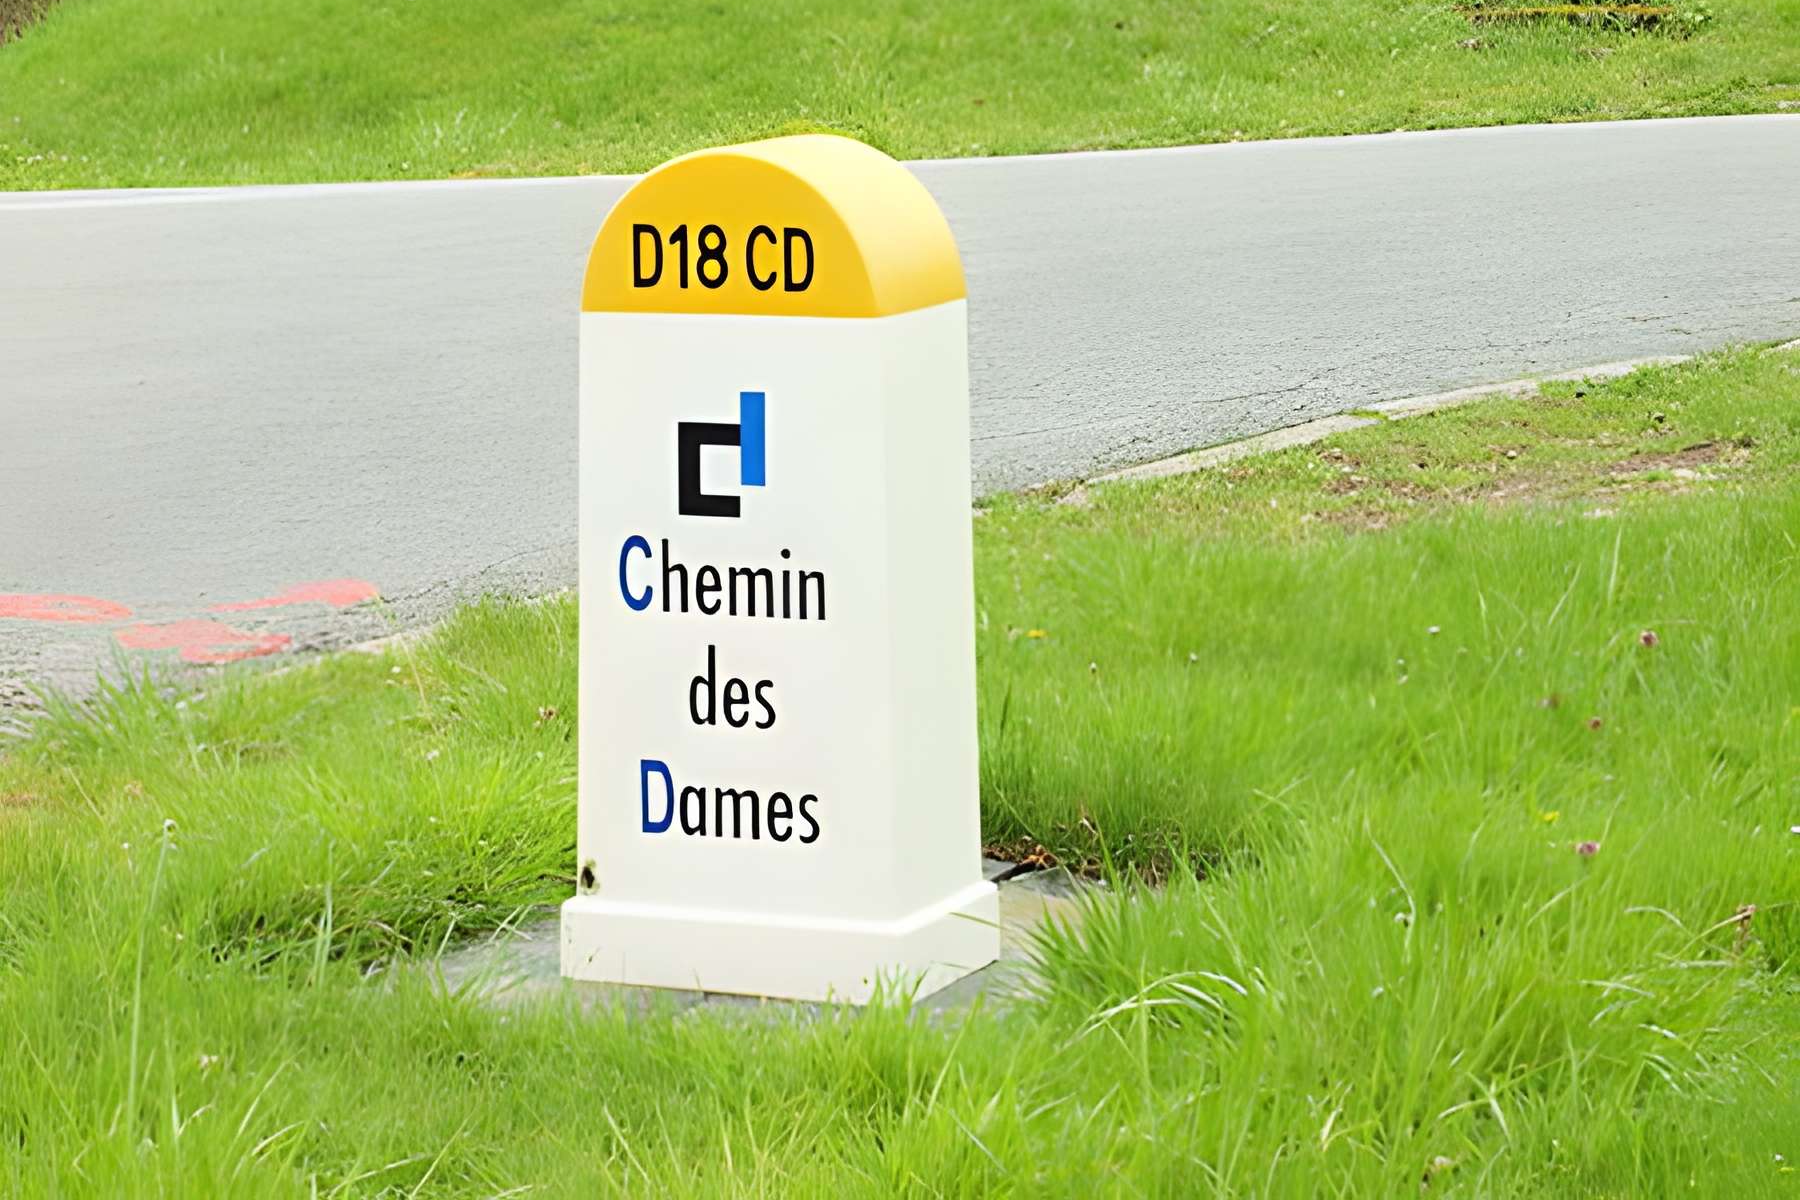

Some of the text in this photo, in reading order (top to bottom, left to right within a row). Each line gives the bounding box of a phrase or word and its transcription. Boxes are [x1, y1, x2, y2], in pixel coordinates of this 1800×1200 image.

[632, 223, 815, 293] D18 CD
[619, 534, 827, 622] Chemin
[689, 644, 776, 730] des
[640, 759, 820, 844] Dames
